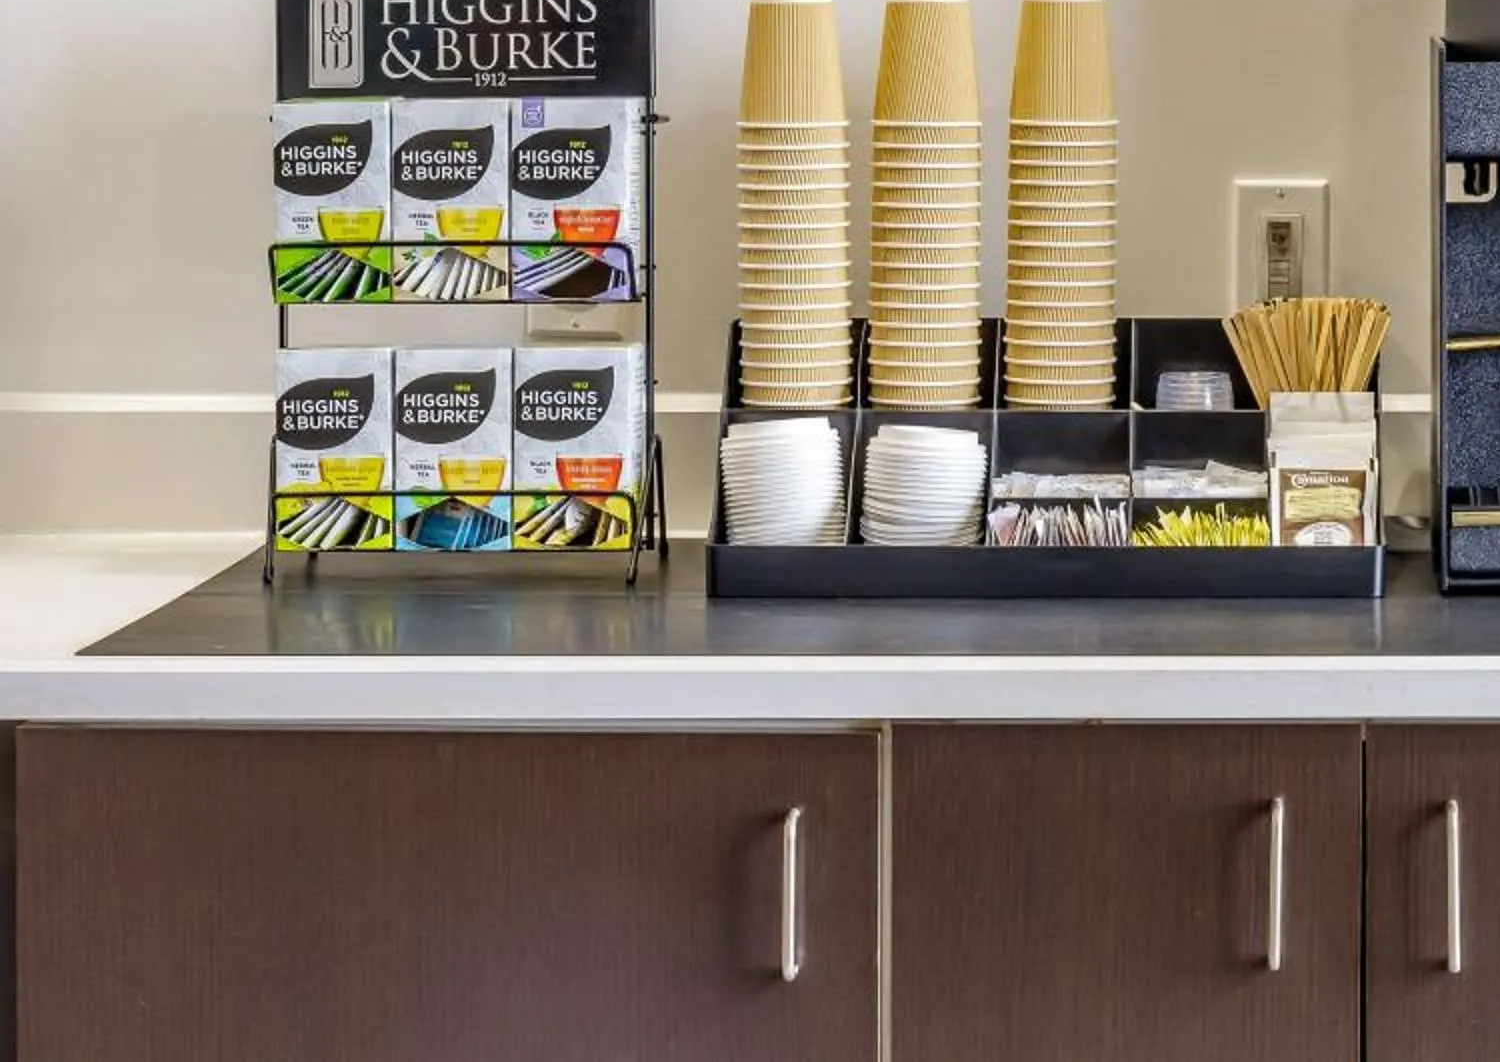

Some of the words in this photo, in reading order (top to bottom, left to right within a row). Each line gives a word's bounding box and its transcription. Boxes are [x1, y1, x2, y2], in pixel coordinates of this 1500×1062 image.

[435, 27, 597, 70] BURKE
[472, 69, 509, 89] 1912
[281, 145, 357, 160] HIGGINS
[401, 150, 477, 165] HIGGINS
[519, 150, 595, 164] HIGGINS
[403, 393, 480, 408] HIGGINS
[521, 391, 597, 405] HIGGINS
[283, 399, 359, 414] HIGGINS
